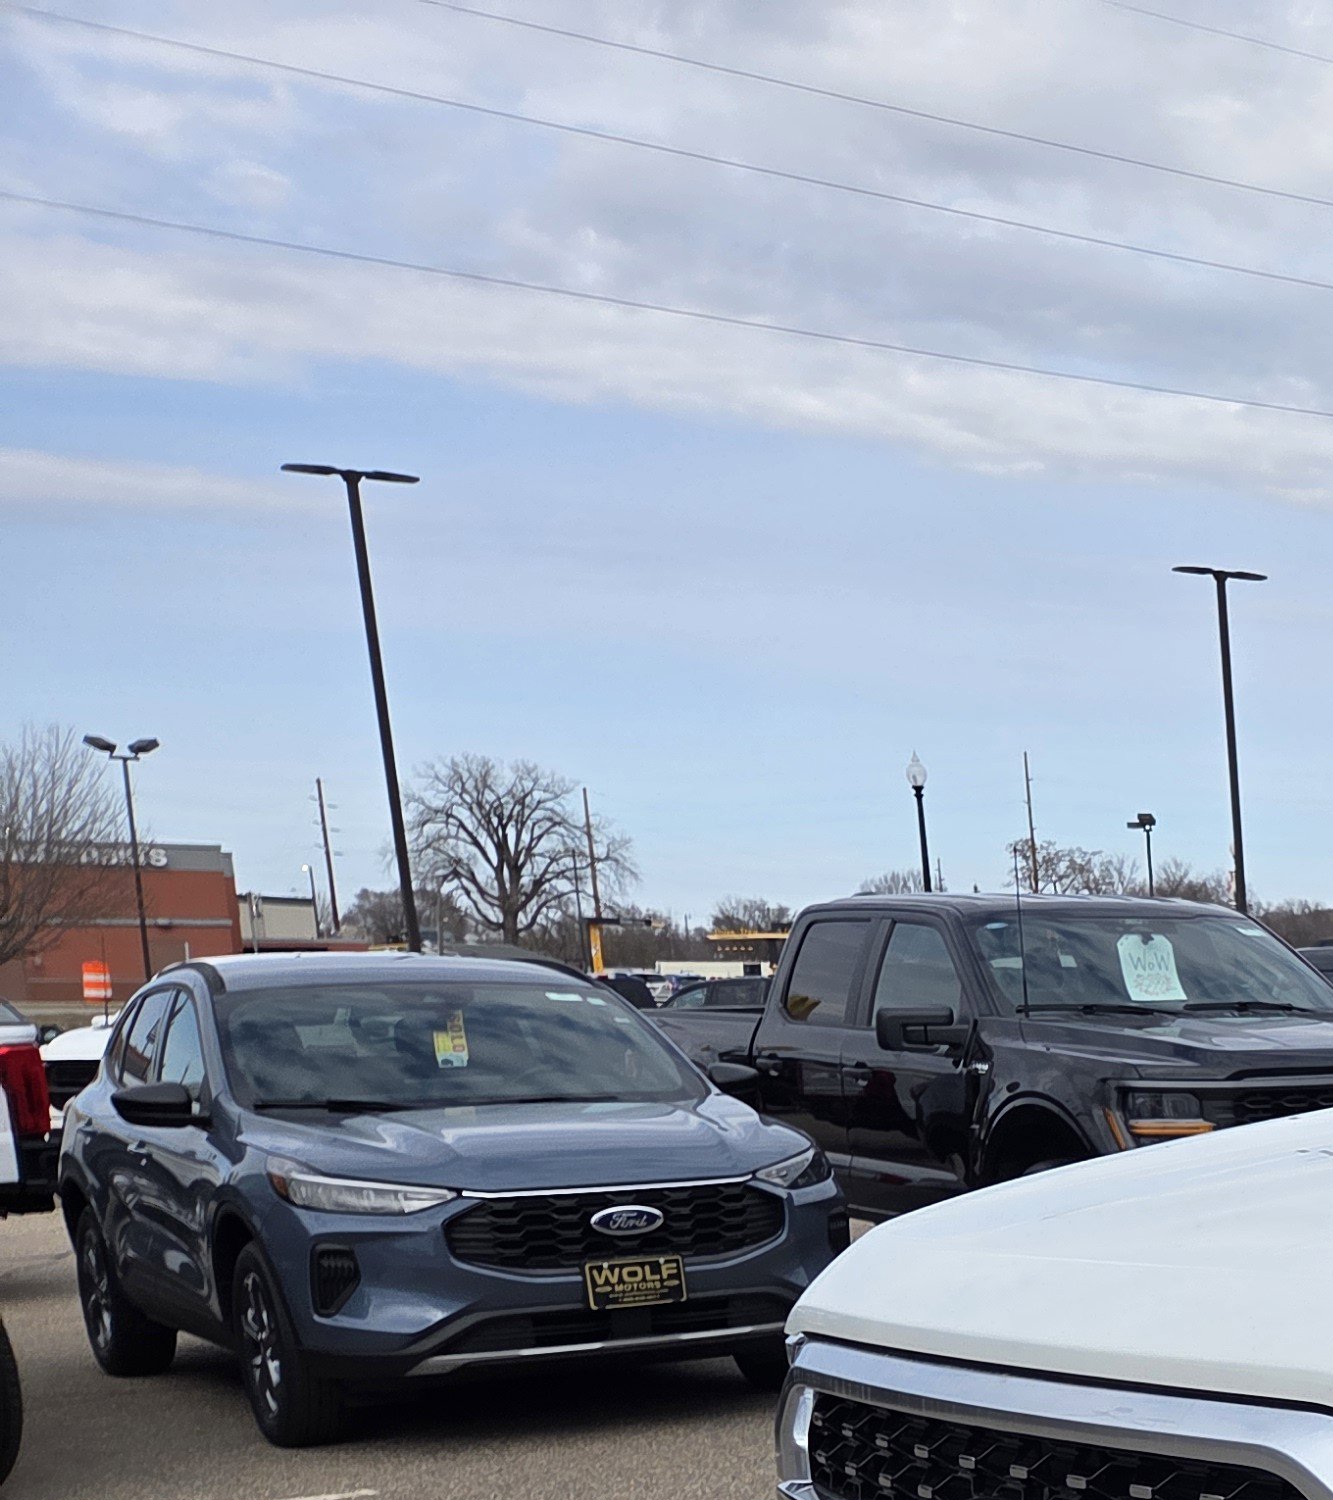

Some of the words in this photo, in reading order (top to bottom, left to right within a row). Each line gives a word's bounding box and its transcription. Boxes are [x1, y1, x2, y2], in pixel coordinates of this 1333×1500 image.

[609, 1211, 648, 1230] Ford
[592, 1263, 678, 1286] WOLF
[614, 1280, 661, 1293] MOTORS
